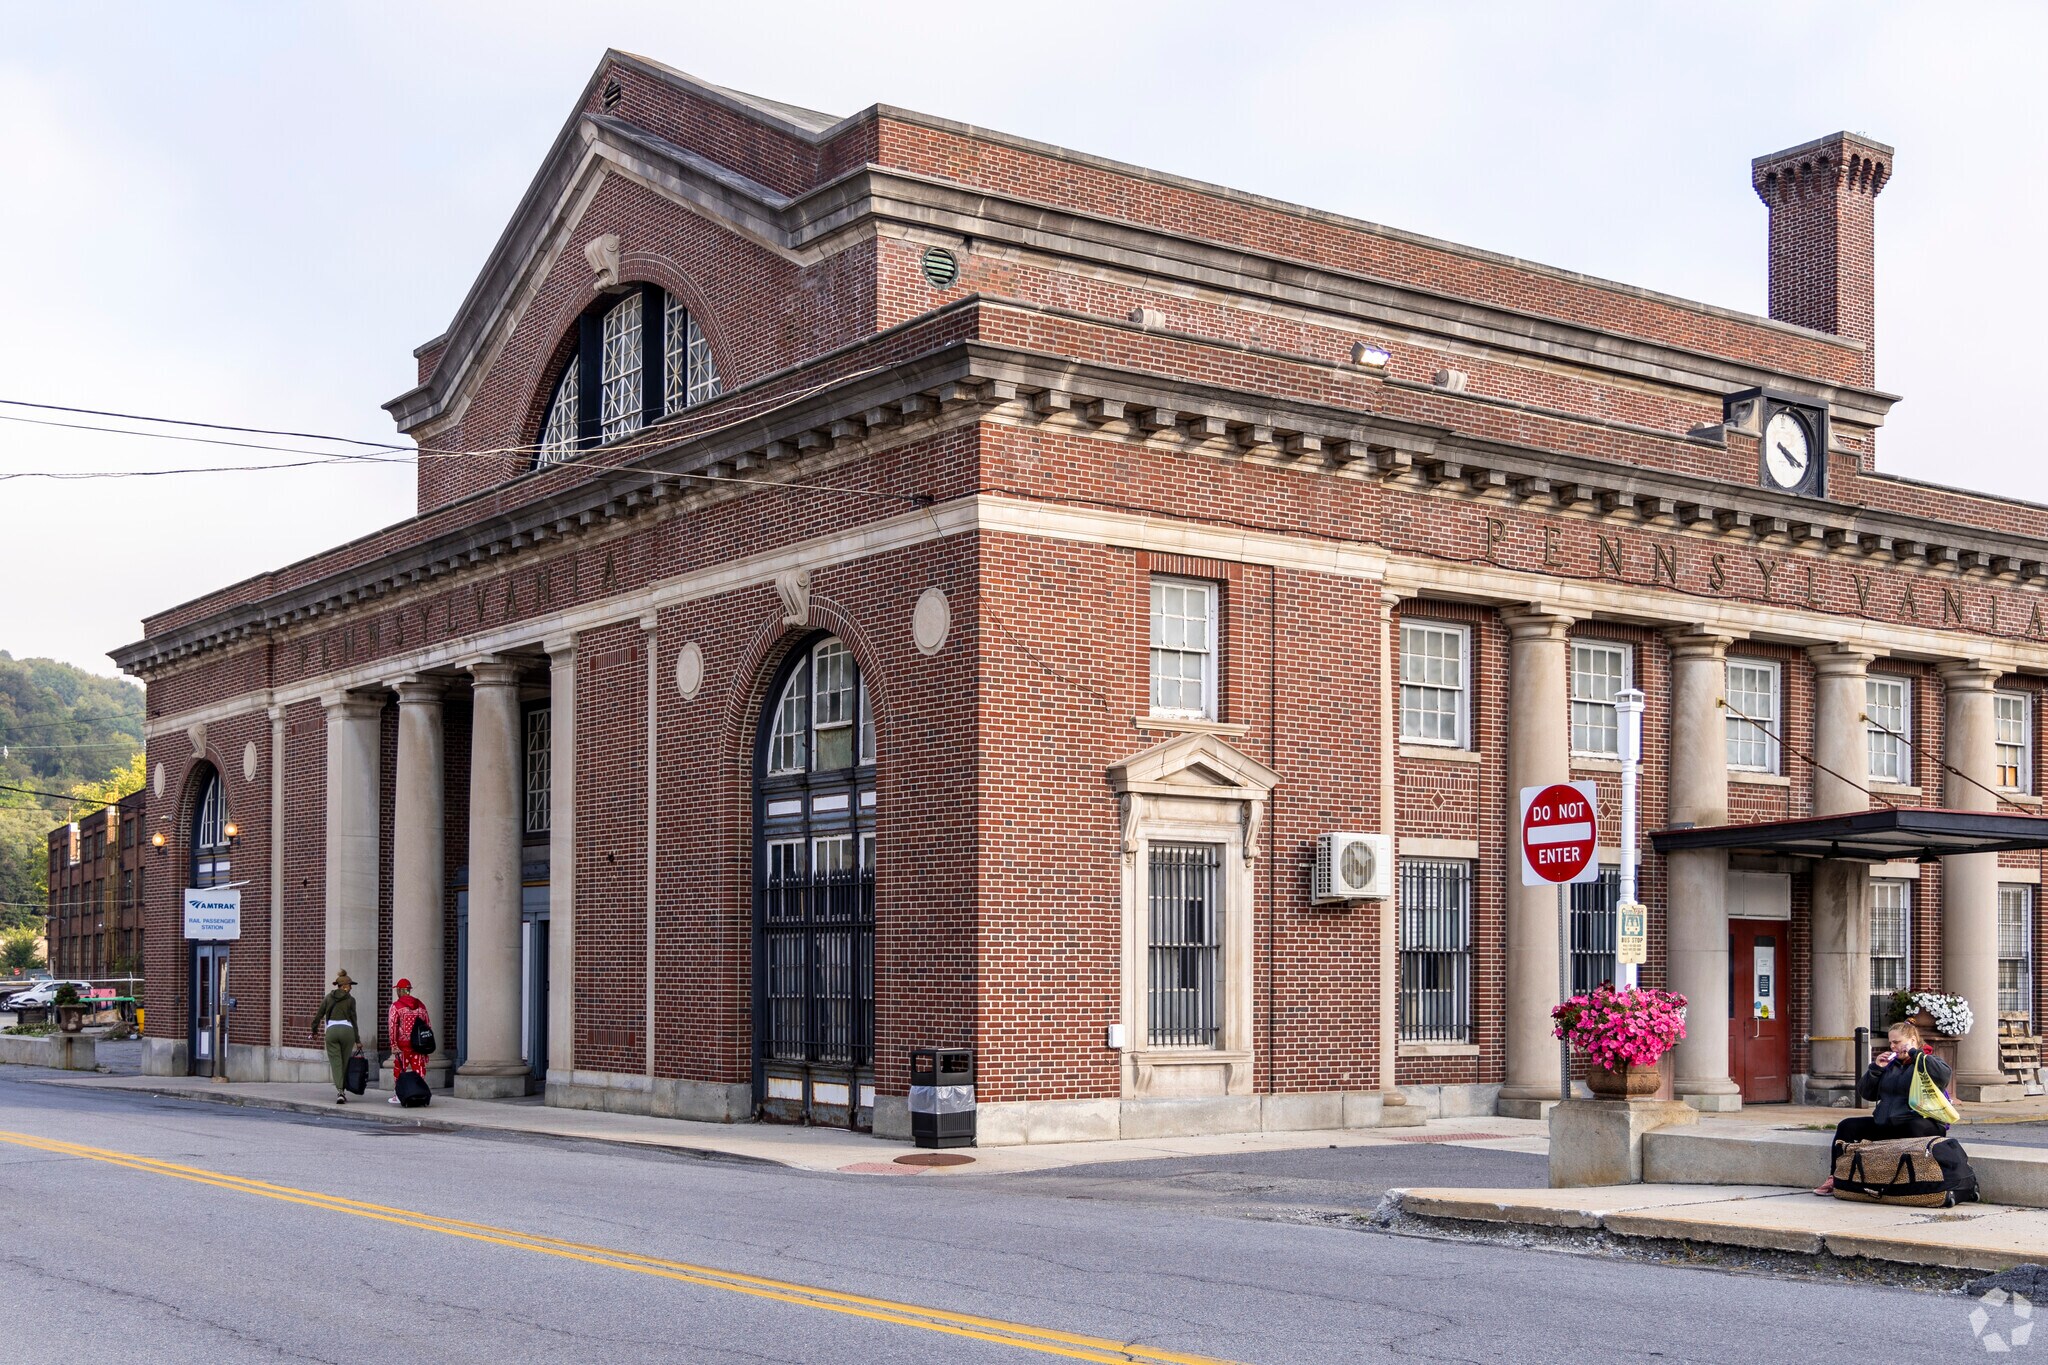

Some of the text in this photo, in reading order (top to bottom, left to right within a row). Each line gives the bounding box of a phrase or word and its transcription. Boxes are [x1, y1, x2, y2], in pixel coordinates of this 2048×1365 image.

[1486, 516, 2045, 636] PENNSYLVANIA
[300, 550, 618, 675] PENNSYLVANIA
[1533, 802, 1584, 821] DO NOT
[1539, 846, 1580, 864] ENTER
